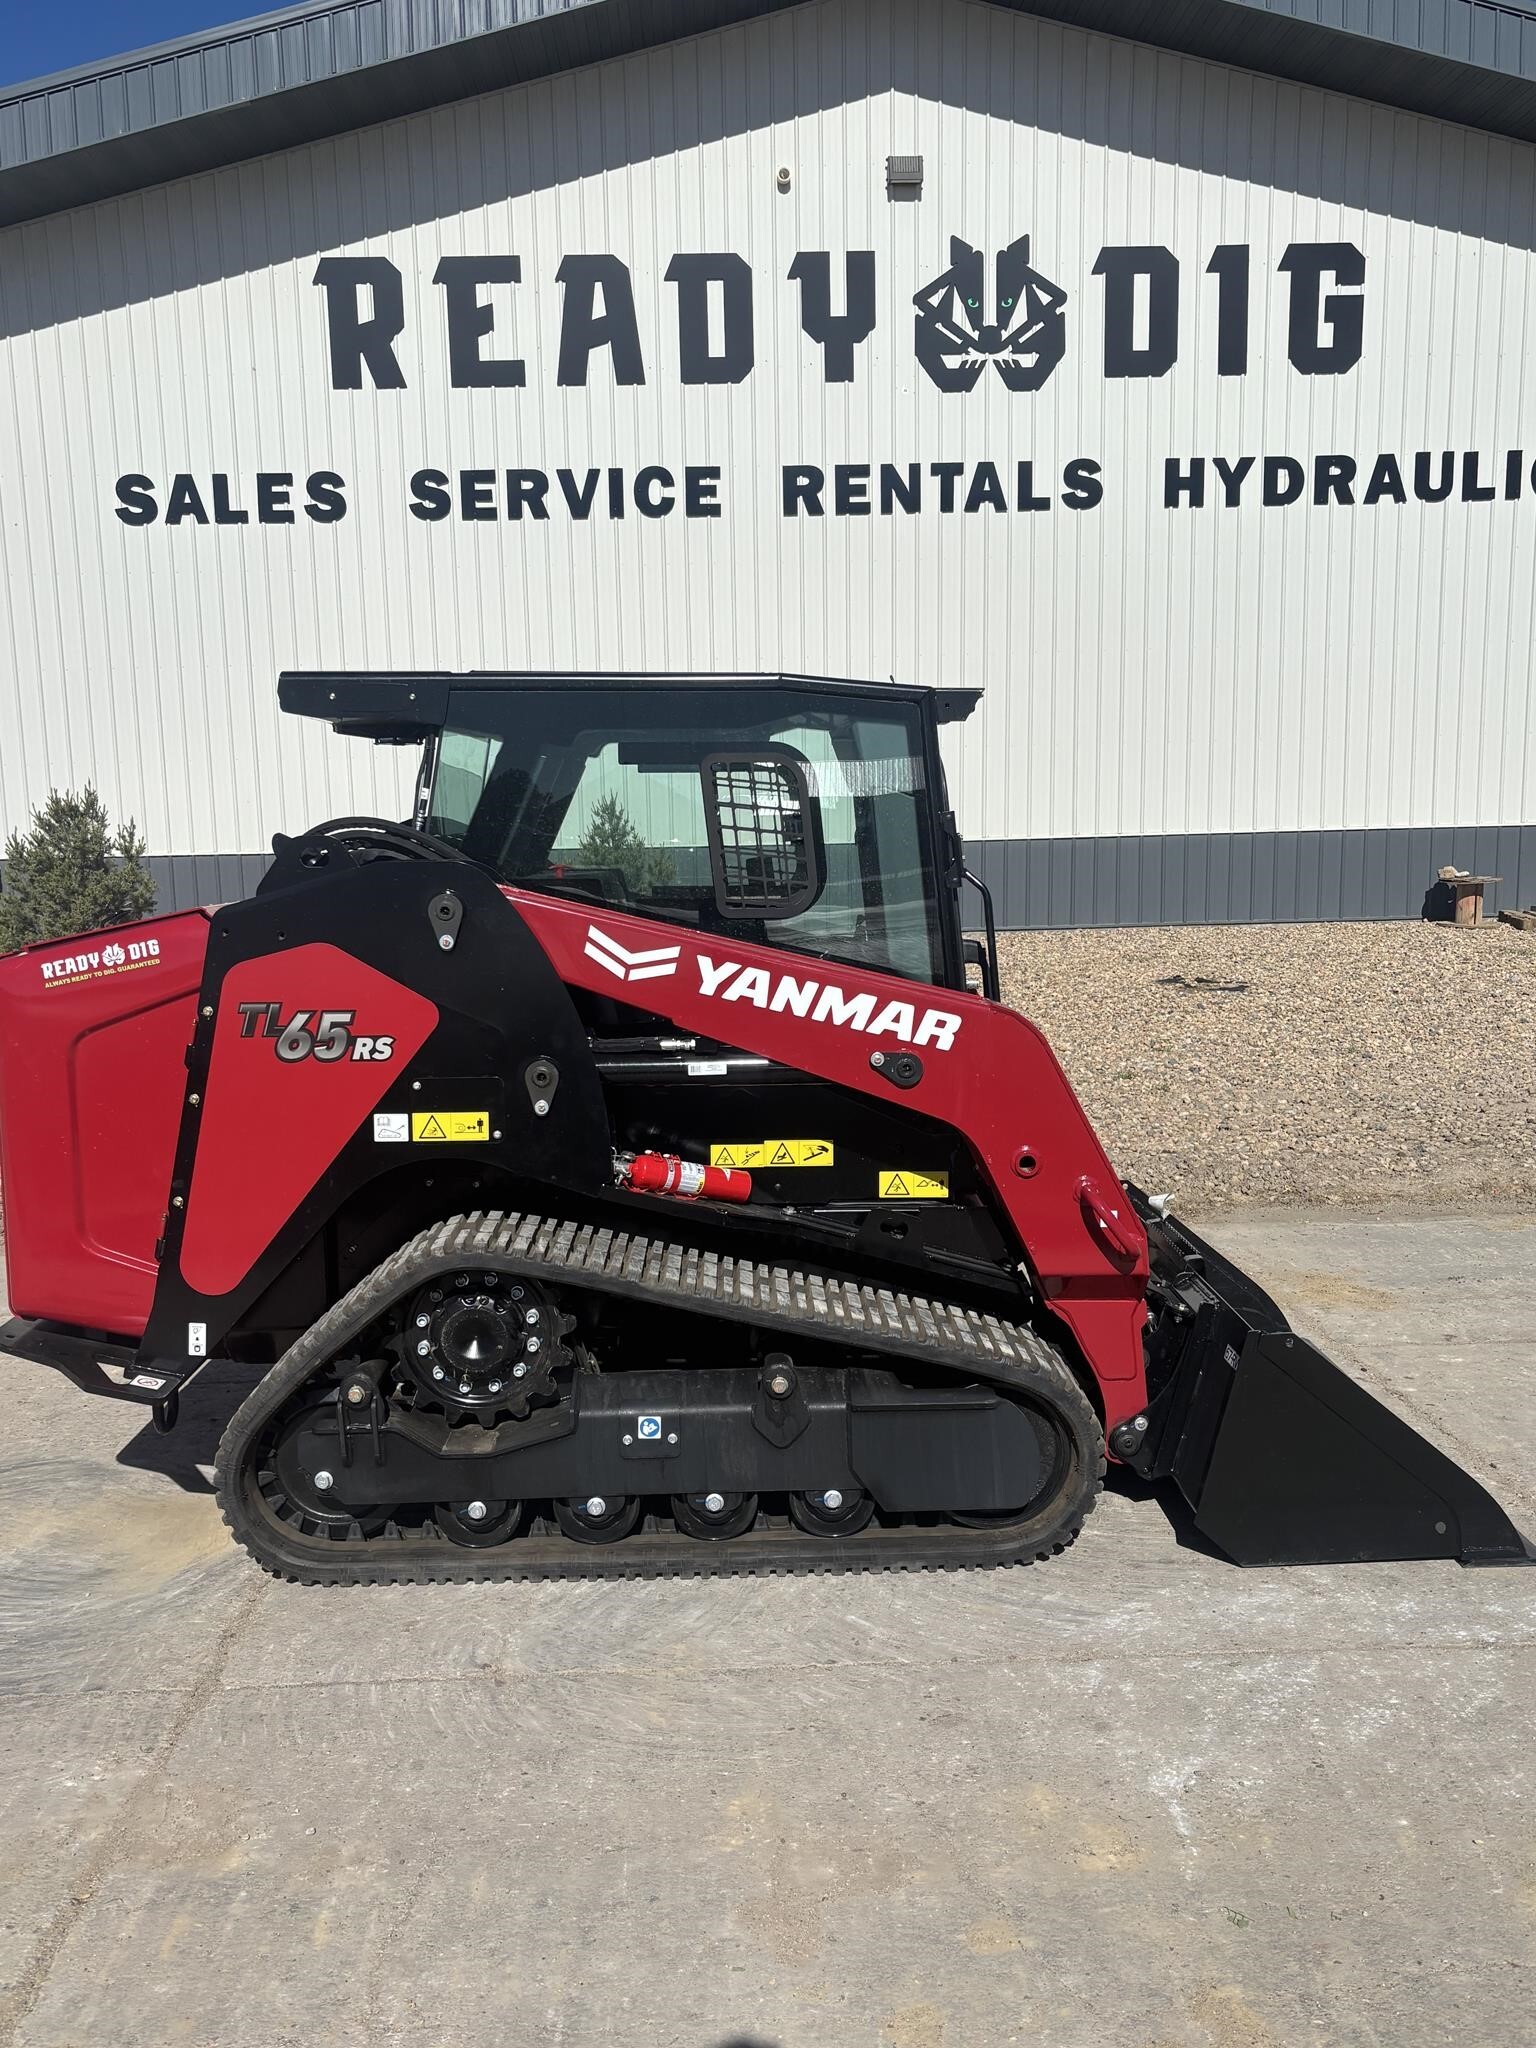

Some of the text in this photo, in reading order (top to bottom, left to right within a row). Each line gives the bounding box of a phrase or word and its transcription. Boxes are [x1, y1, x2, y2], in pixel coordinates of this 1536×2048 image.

[312, 242, 1366, 391] READY DIG
[115, 449, 1536, 527] SALES SERVICE RENTALS HYDRAULI
[40, 938, 160, 980] READY DIG
[45, 977, 71, 989] ALWAYS
[71, 973, 93, 983] READY
[117, 958, 161, 973] GUARANTEED
[696, 954, 963, 1052] YANMAR
